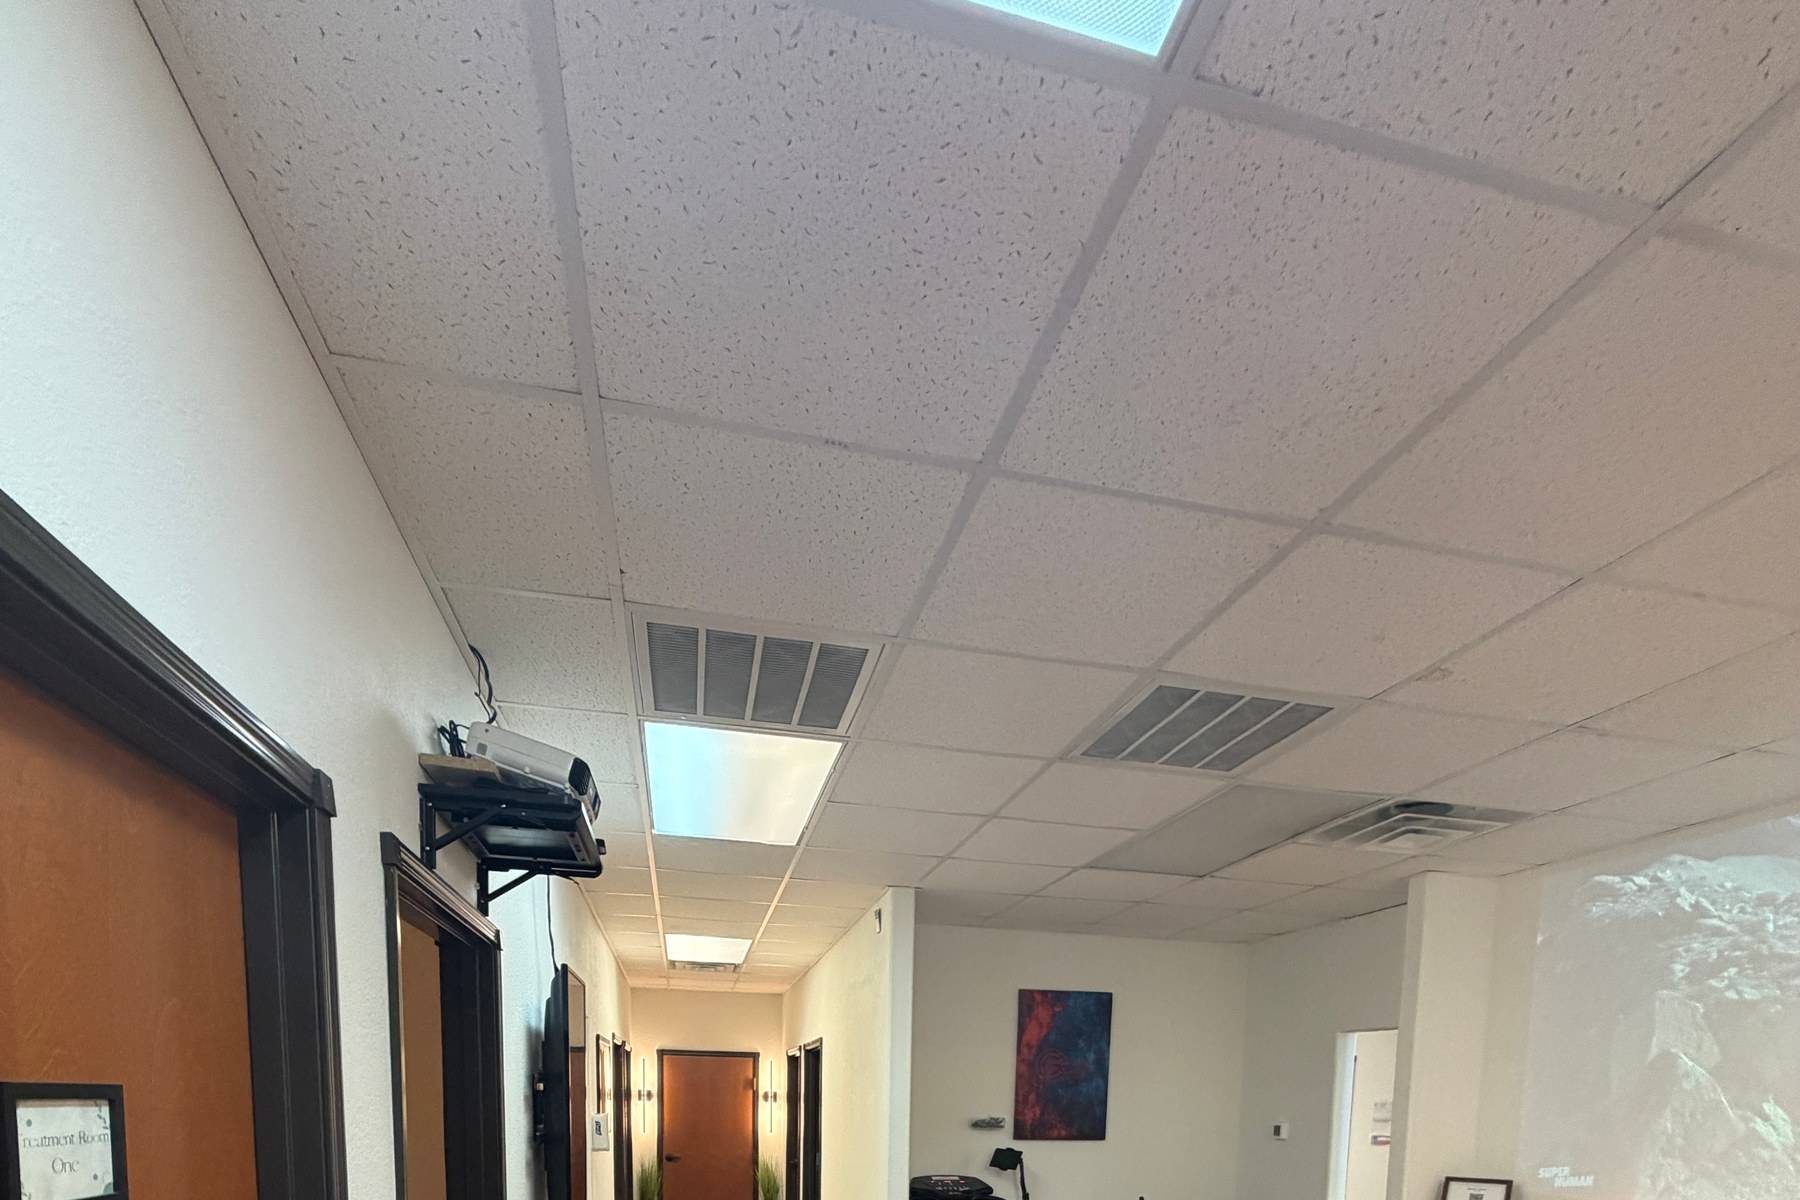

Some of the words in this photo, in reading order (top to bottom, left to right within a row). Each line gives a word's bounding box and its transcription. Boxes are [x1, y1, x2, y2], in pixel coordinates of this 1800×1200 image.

[23, 1134, 74, 1148] reatment
[79, 1130, 108, 1145] Room
[52, 1157, 80, 1174] One
